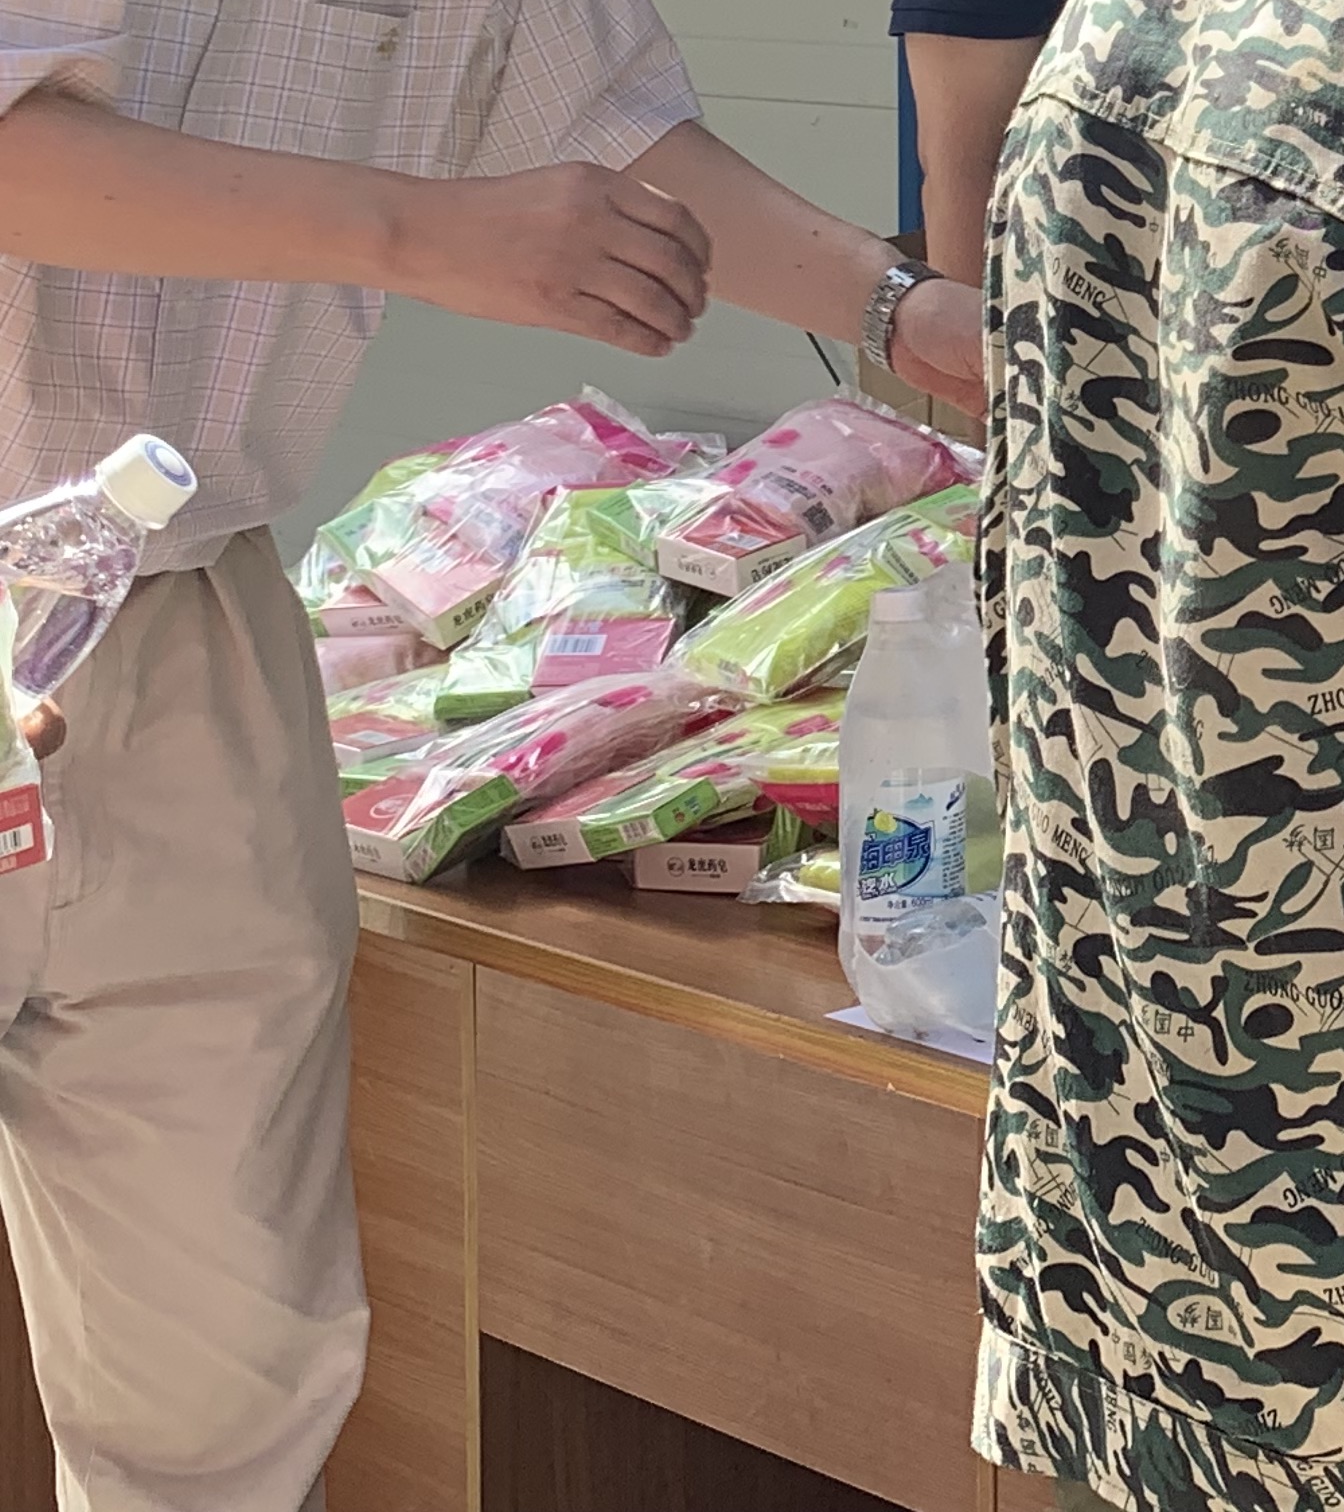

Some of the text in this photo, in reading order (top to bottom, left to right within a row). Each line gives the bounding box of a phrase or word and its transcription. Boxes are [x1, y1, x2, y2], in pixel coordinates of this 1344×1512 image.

[1294, 392, 1331, 419] GUO
[687, 856, 729, 875] 龙虎药皂
[1304, 986, 1343, 1011] GUO
